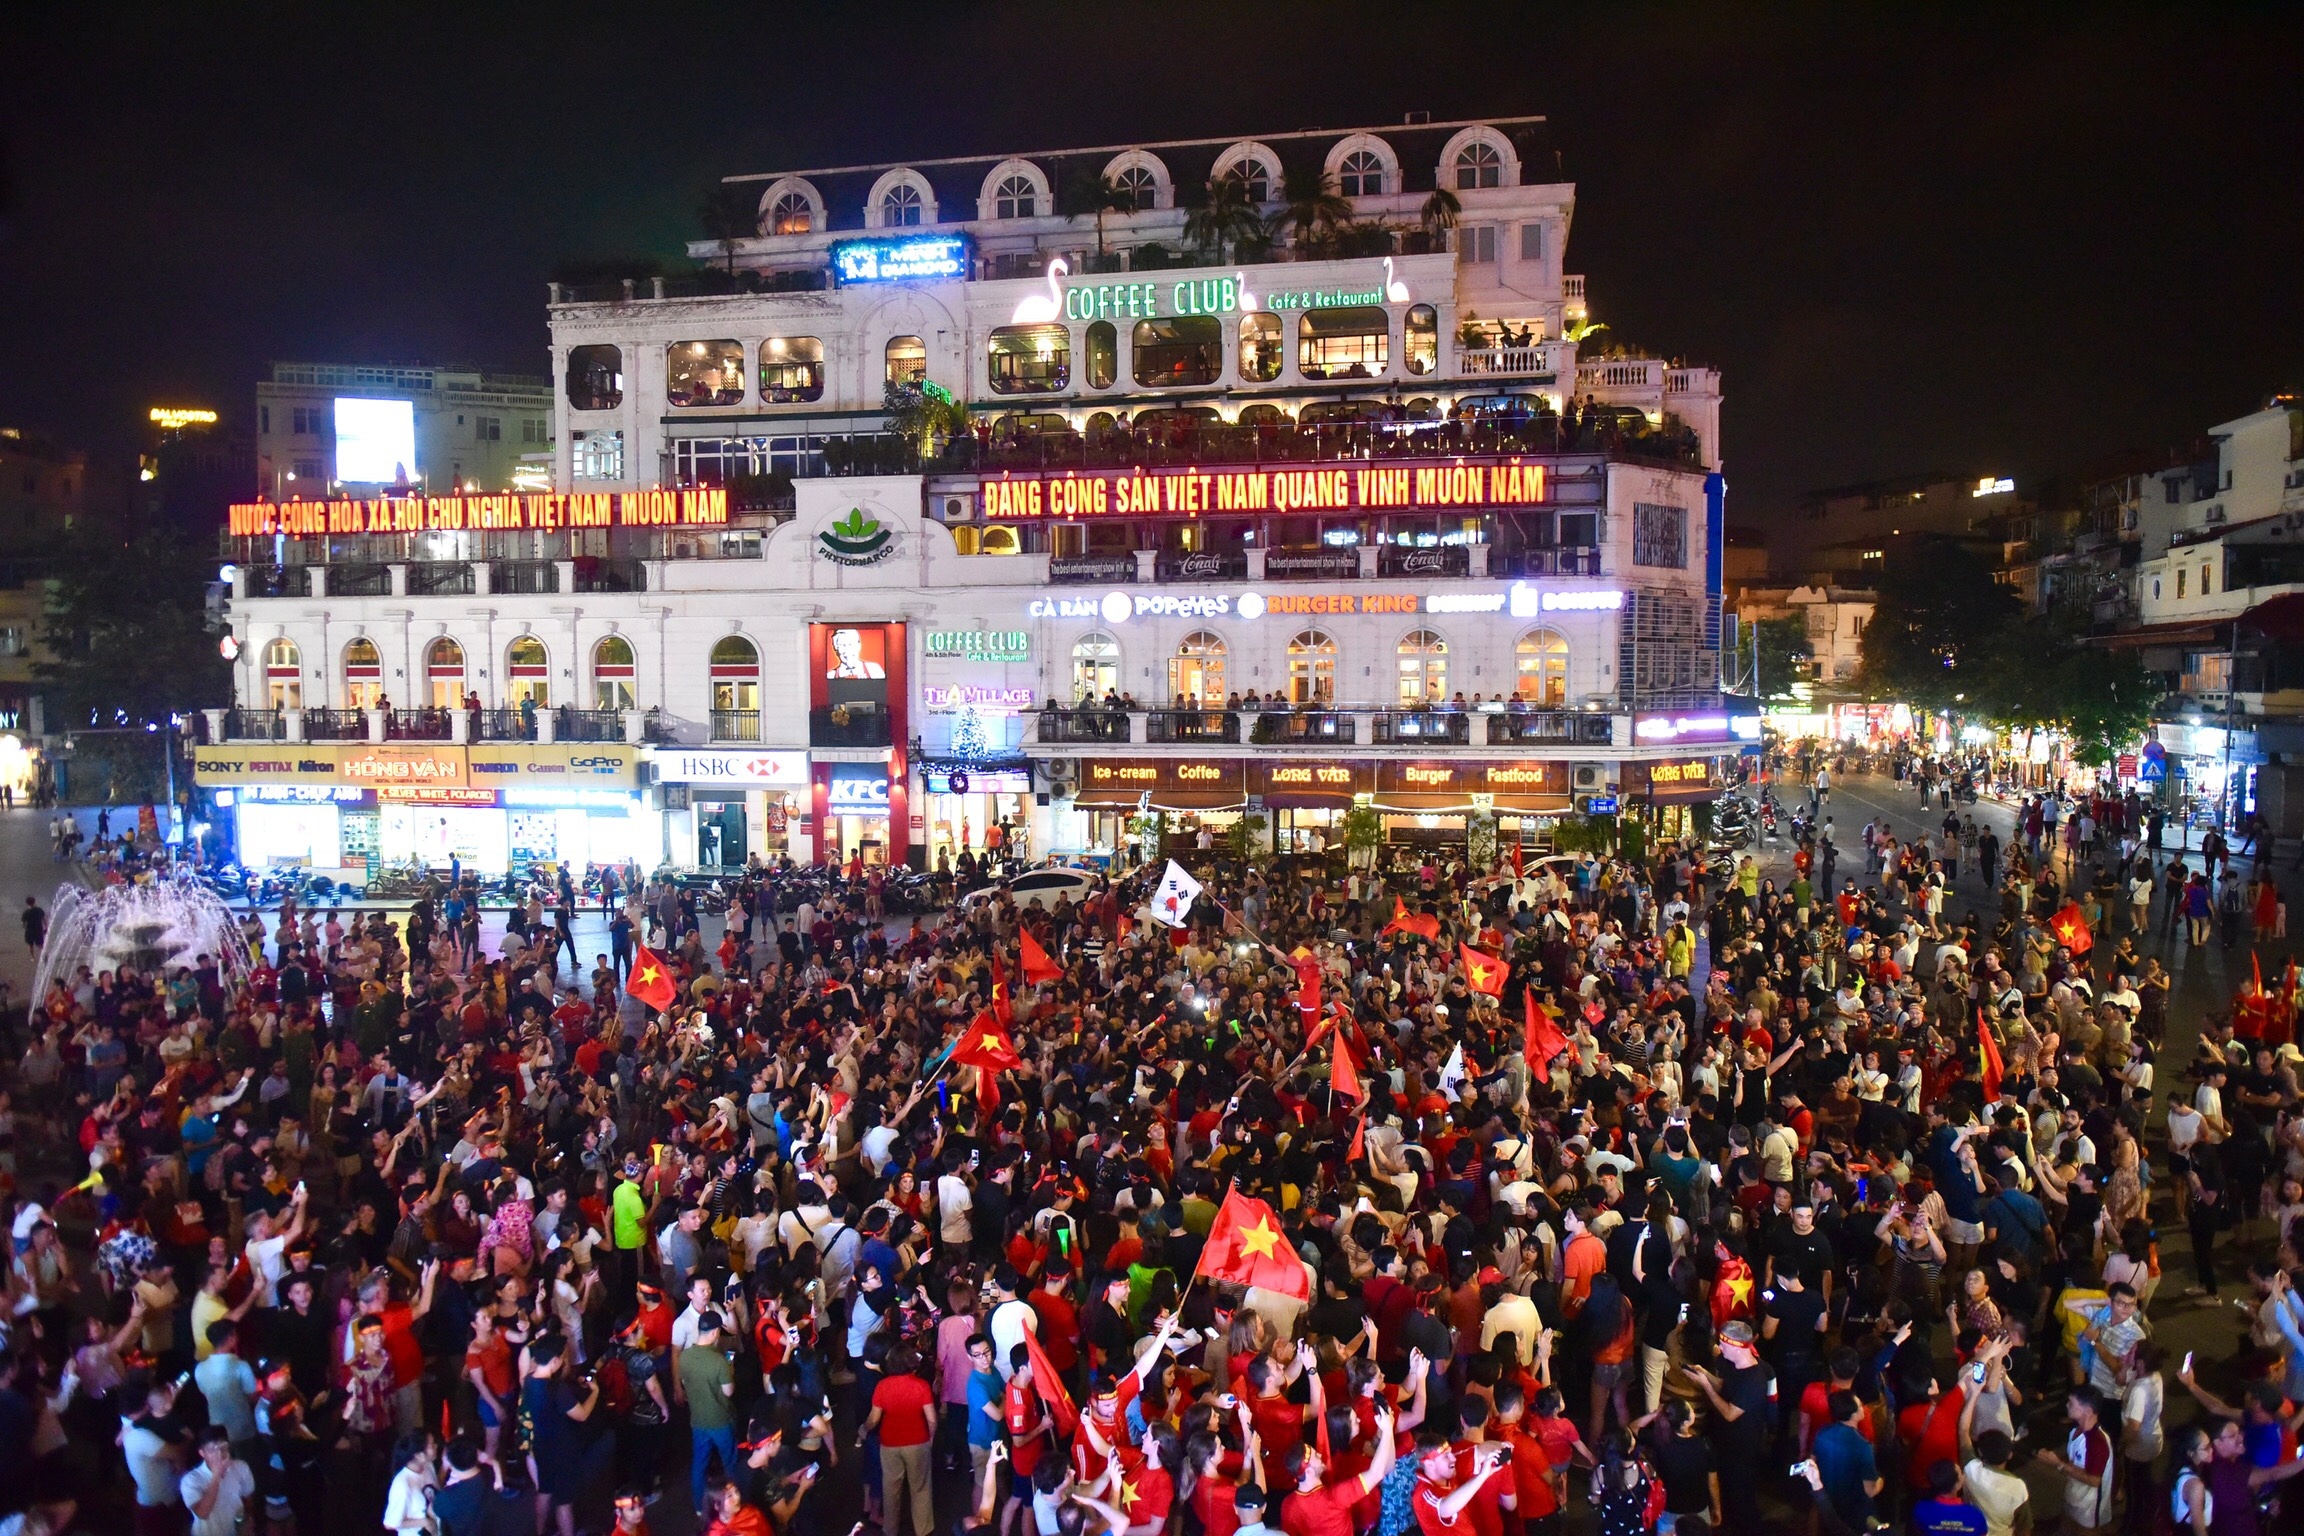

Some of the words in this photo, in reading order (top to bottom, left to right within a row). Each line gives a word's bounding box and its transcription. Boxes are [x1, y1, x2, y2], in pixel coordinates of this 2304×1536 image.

[1066, 283, 1157, 319] COFFEE
[1173, 277, 1236, 315] CLUB
[1267, 293, 1298, 310] Café
[1301, 292, 1311, 307] &
[1315, 287, 1384, 307] Restaurant
[984, 470, 1042, 517] ĐẢNG
[1049, 470, 1107, 521] CỘNG
[1116, 465, 1160, 513] SẢN
[1164, 466, 1212, 518] VIỆT
[1216, 473, 1268, 511] NAM
[1273, 470, 1348, 512] QUANG
[1357, 468, 1410, 506] VINH
[1416, 458, 1484, 505] MUÔN
[1490, 456, 1545, 503] NĂM
[279, 494, 326, 541] CỘNG
[328, 492, 364, 533] HÒA
[368, 492, 391, 531] XÃ
[394, 490, 424, 538] HỘI
[428, 487, 464, 530] CHỦ
[467, 489, 523, 528] NGHĨA
[526, 487, 567, 534] VIỆT
[568, 493, 612, 526] NAM
[621, 483, 677, 526] MUÔN
[683, 481, 727, 525] NĂM
[818, 545, 894, 567] PHYTOPHARCO
[1268, 557, 1277, 568] The
[1277, 557, 1288, 568] best
[1322, 556, 1336, 567] show
[1051, 563, 1060, 575] The
[1060, 564, 1071, 574] best
[1103, 562, 1115, 573] show
[1267, 594, 1354, 614] BURGER
[1361, 594, 1417, 613] KING
[927, 632, 982, 650] COFFEE
[989, 632, 1027, 650] CLUB
[991, 652, 1027, 661] Restaurant
[965, 686, 1031, 702] VILLAGE
[197, 761, 243, 772] SONY
[249, 761, 293, 772] PENTAX
[298, 760, 334, 772] Nikon
[410, 758, 457, 777] VÂN
[471, 763, 518, 773] TAMRON
[527, 763, 565, 773] Canon
[571, 757, 623, 767] GoPro
[683, 758, 739, 776] HSBC
[1093, 765, 1111, 779] Ice
[1120, 767, 1157, 779] cream
[1178, 764, 1220, 779] Coffee
[1272, 768, 1312, 782] LONG
[1406, 767, 1452, 784] Burger
[1487, 767, 1543, 783] Fastfood
[1650, 766, 1681, 781] LONG
[420, 790, 449, 800] WHITE,
[830, 779, 888, 800] KFC
